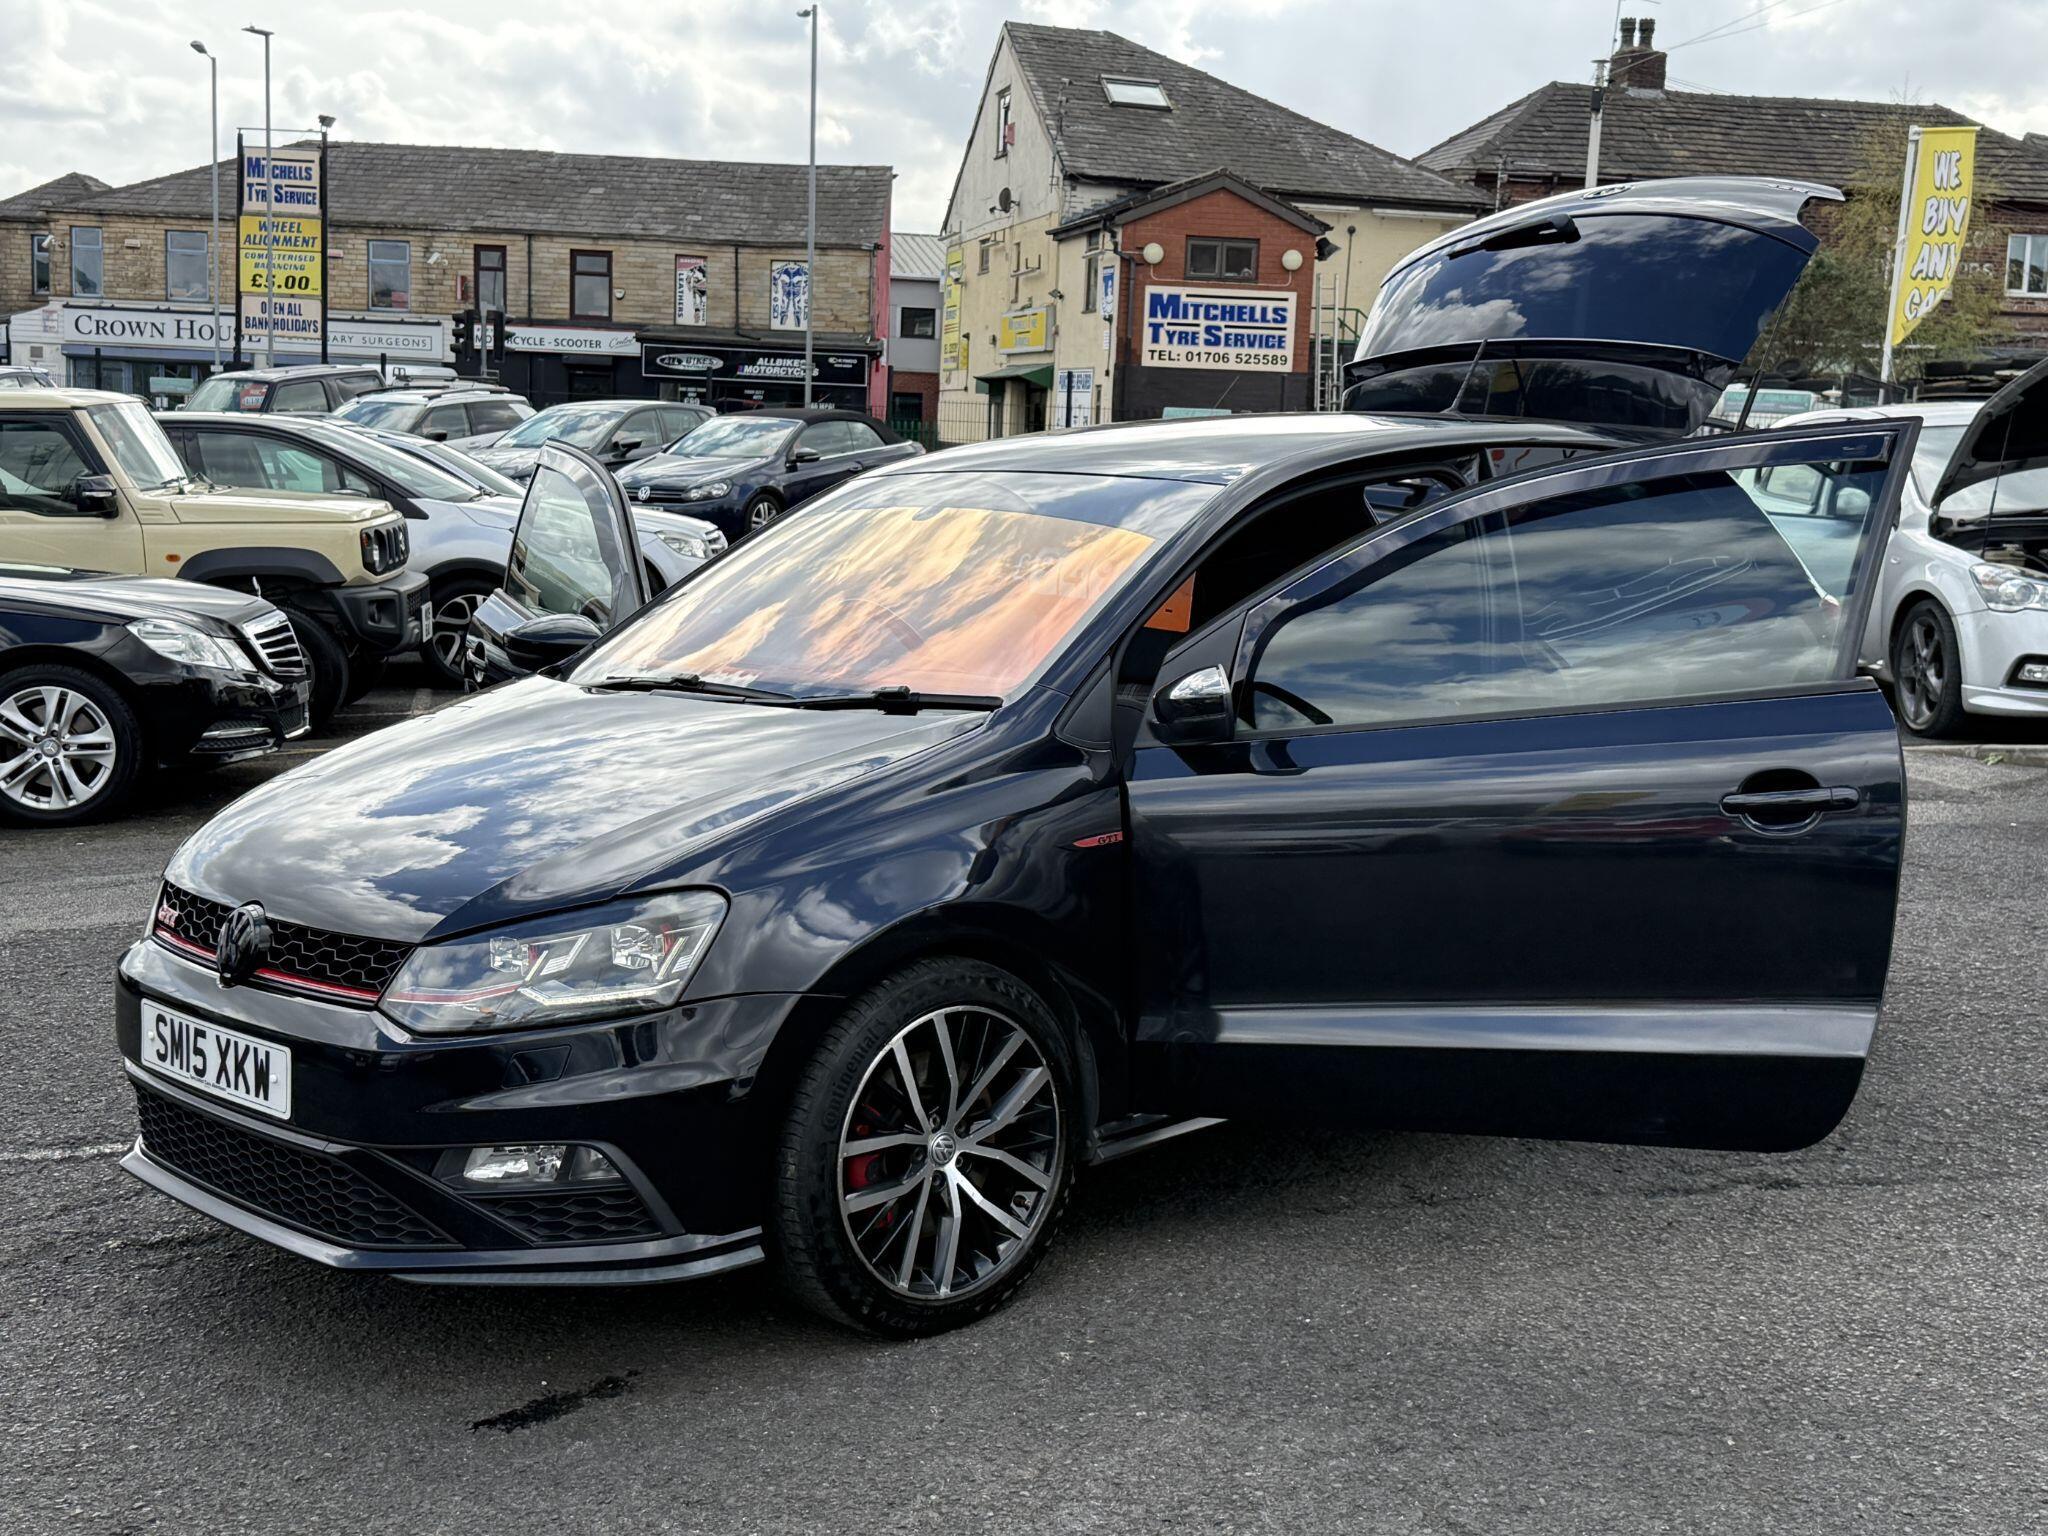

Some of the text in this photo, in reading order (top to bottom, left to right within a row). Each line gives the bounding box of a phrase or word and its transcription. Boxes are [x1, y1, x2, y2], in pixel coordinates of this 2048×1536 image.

[246, 156, 313, 181] MICHELLS
[1933, 150, 1962, 190] WE
[246, 183, 317, 205] TYR SERVICE
[1922, 196, 1968, 236] BUY
[261, 301, 303, 316] OEN ALL
[1149, 293, 1287, 324] MITCHELLS
[1904, 287, 1946, 321] CA
[273, 318, 319, 333] HOLIDAYS
[1148, 322, 1286, 349] TYRE SERVICE
[362, 336, 427, 348] SURGEONS
[554, 338, 602, 349] SCOOTER
[1148, 349, 1288, 366] TEL: 01706 525589
[743, 365, 819, 377] MOTORCYCLS
[1098, 834, 1118, 845] GTI
[156, 1013, 270, 1101] SM15 XKW
[822, 1027, 881, 1132] Continental
